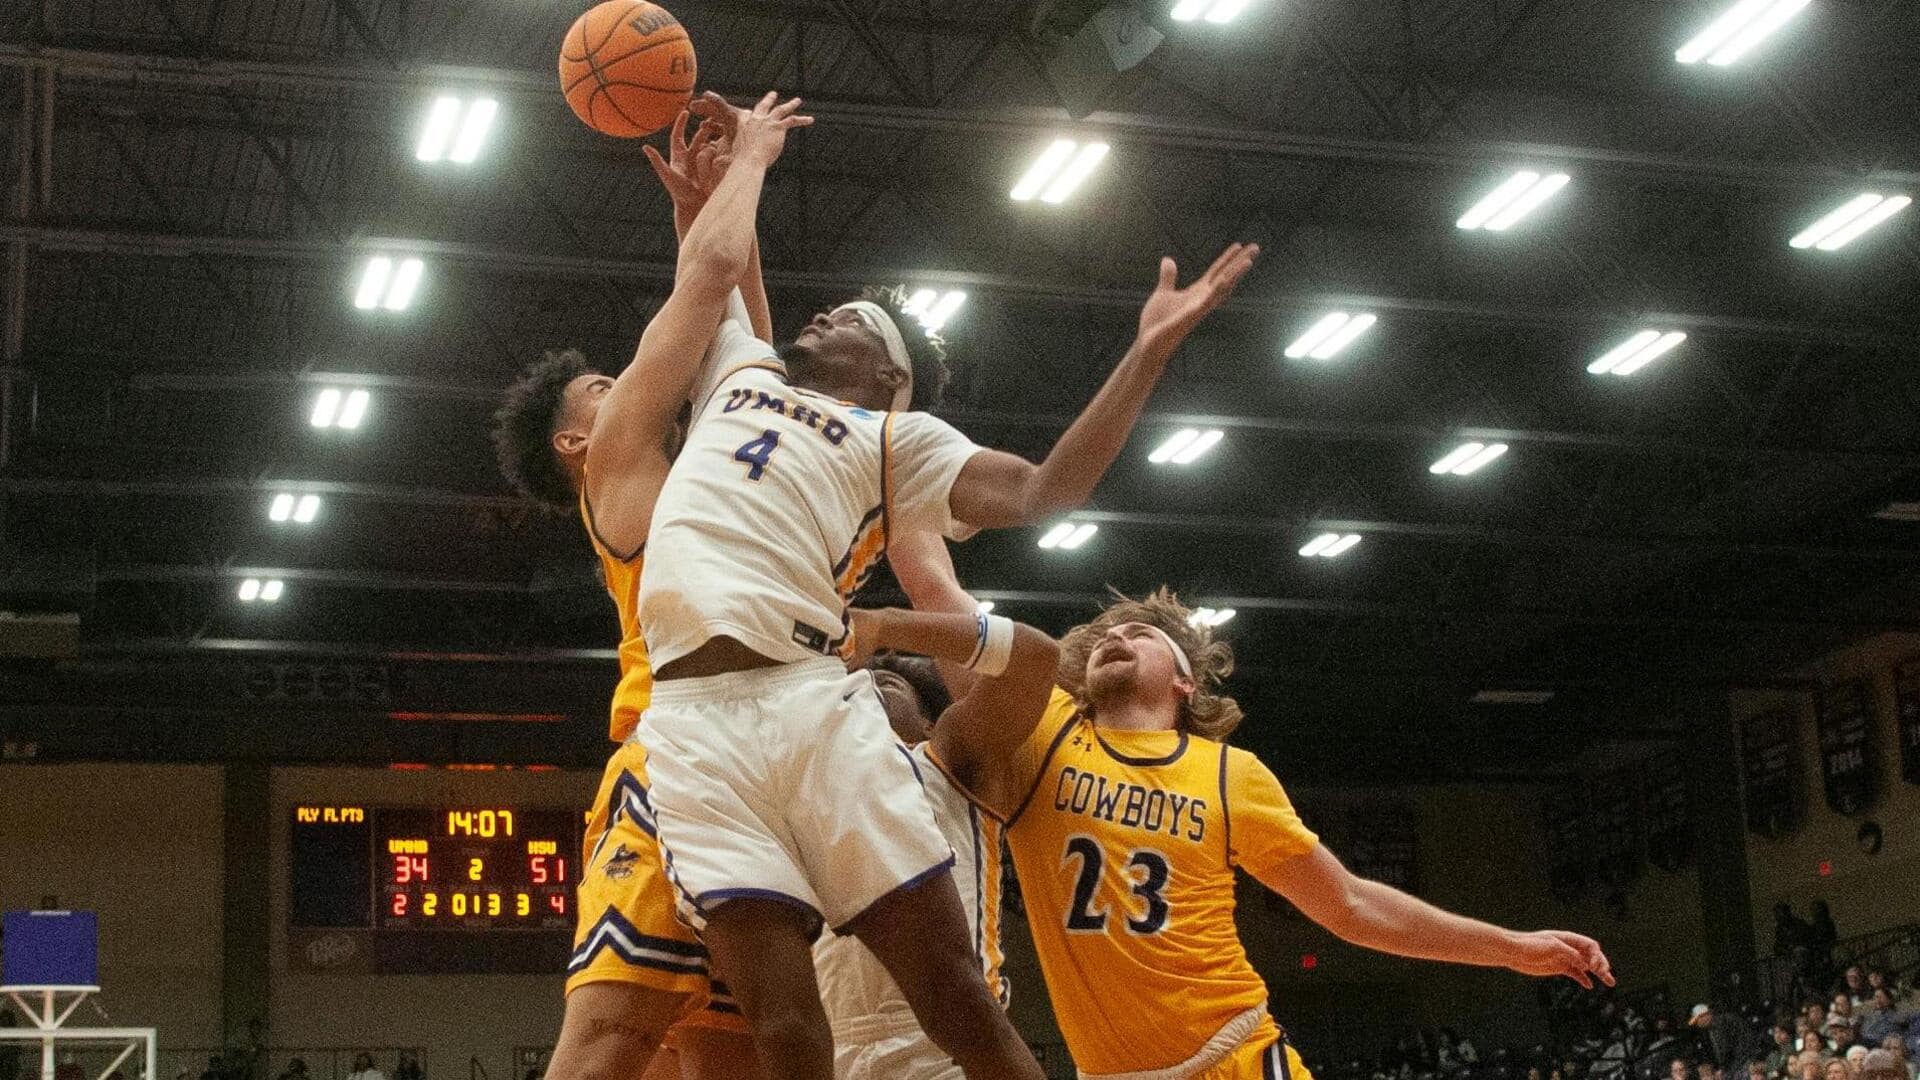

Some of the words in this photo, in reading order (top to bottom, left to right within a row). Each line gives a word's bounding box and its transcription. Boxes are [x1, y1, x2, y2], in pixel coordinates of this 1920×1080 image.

[734, 428, 782, 481] 4
[341, 808, 364, 822] PTS
[1054, 766, 1207, 842] COWBOYS
[449, 810, 513, 837] 14:07
[388, 840, 428, 854] UMHB
[396, 856, 428, 883] 34
[469, 858, 483, 881] 2
[531, 857, 564, 883] 51
[1063, 835, 1171, 935] 23
[394, 894, 407, 915] 2
[423, 894, 437, 916] 2
[516, 894, 530, 916] 3
[551, 895, 565, 914] 4
